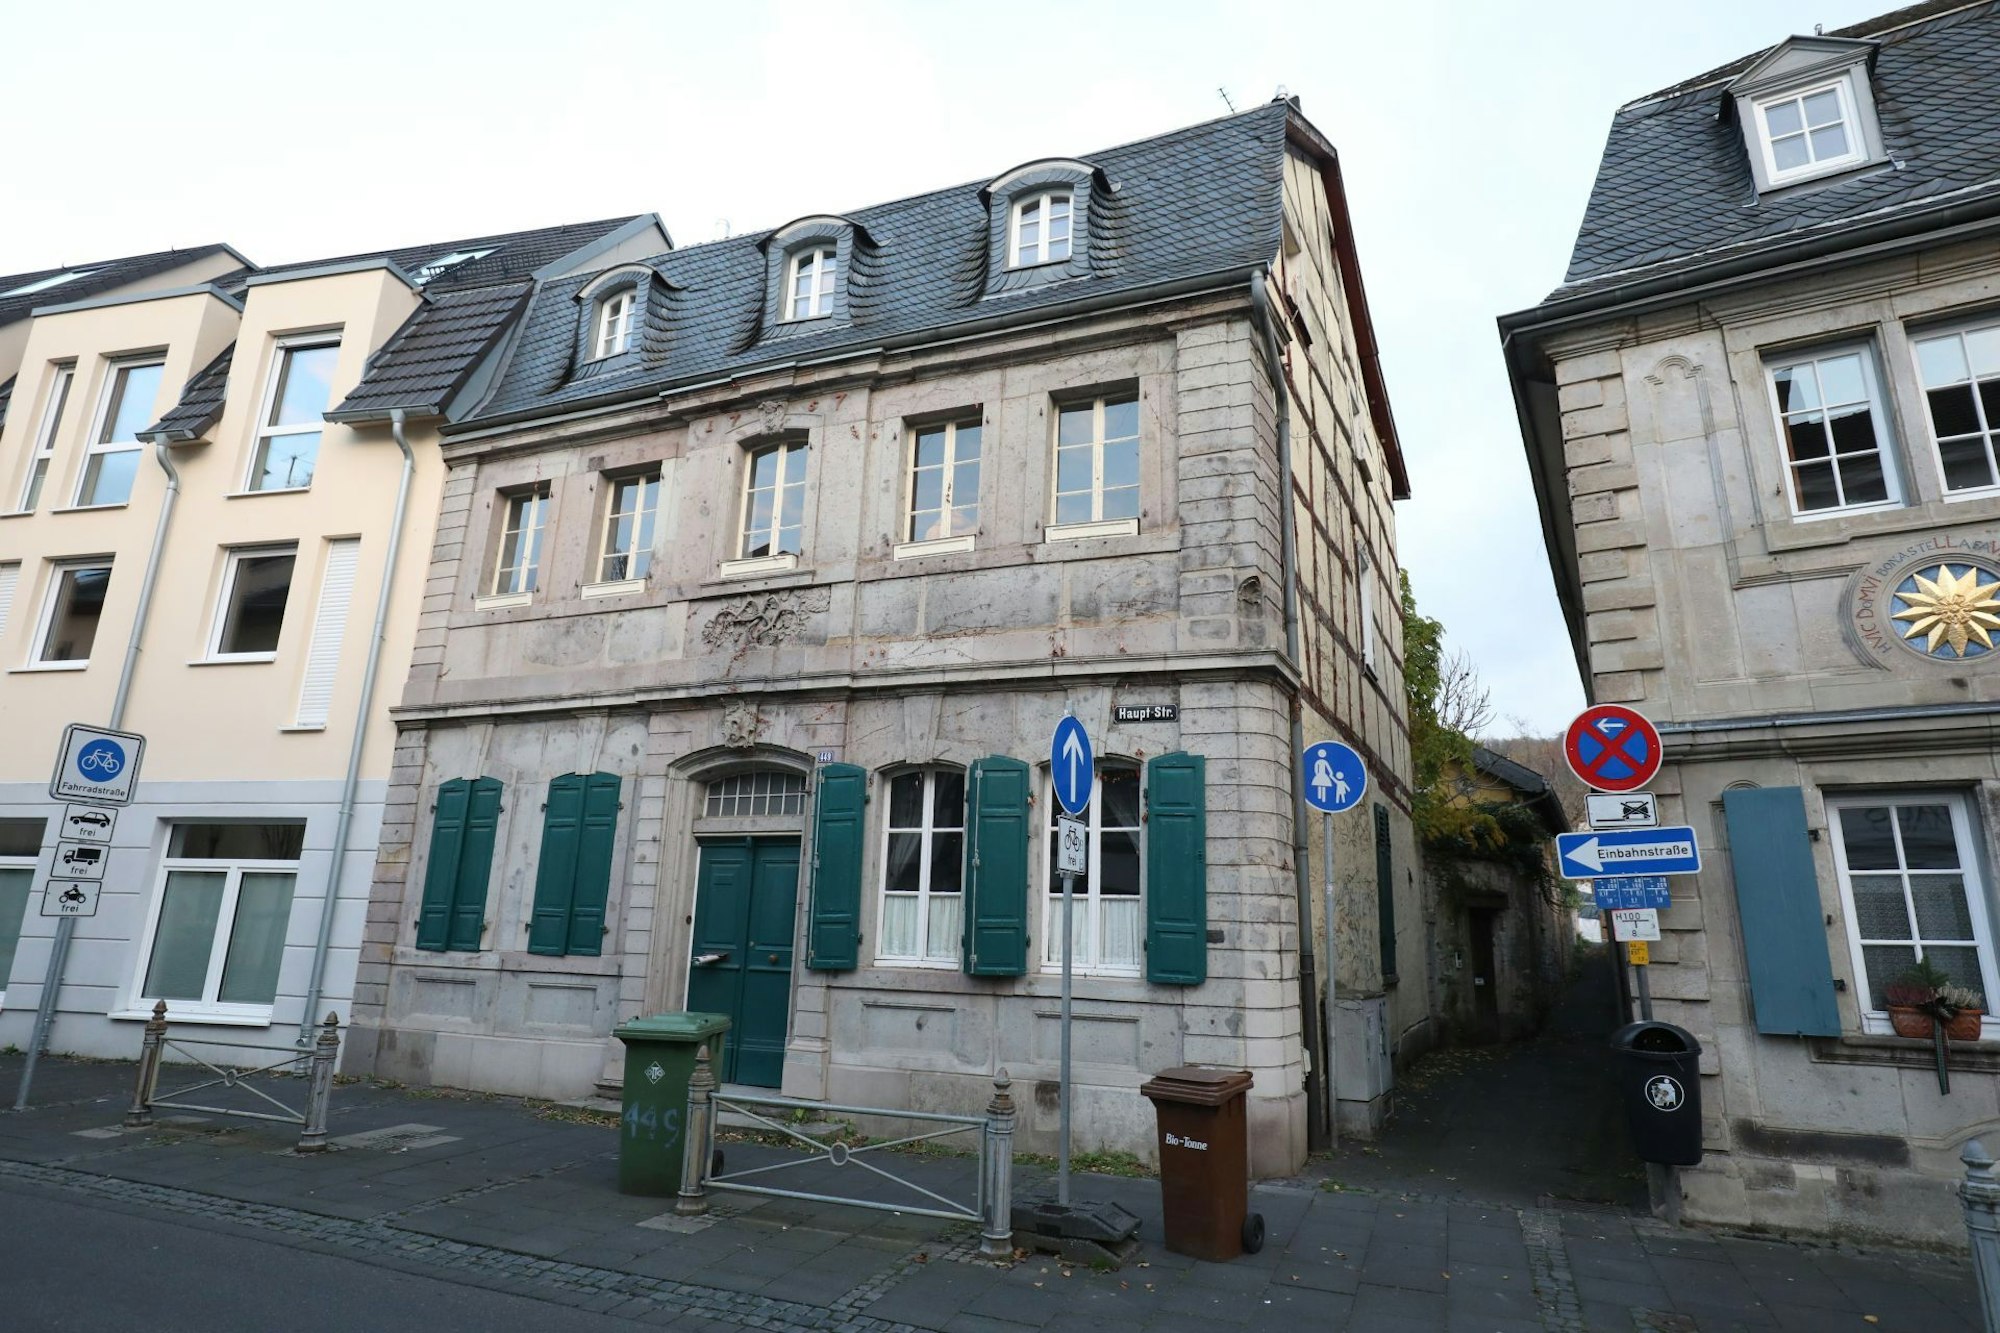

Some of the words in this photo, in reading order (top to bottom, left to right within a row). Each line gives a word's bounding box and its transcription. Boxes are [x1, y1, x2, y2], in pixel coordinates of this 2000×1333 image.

[62, 782, 126, 797] Fahrradstraße
[80, 827, 96, 837] frei
[1598, 845, 1689, 859] Einbahnstraße
[1068, 854, 1077, 866] frei
[70, 866, 88, 875] frei
[61, 904, 79, 912] frei
[1616, 912, 1641, 921] H100
